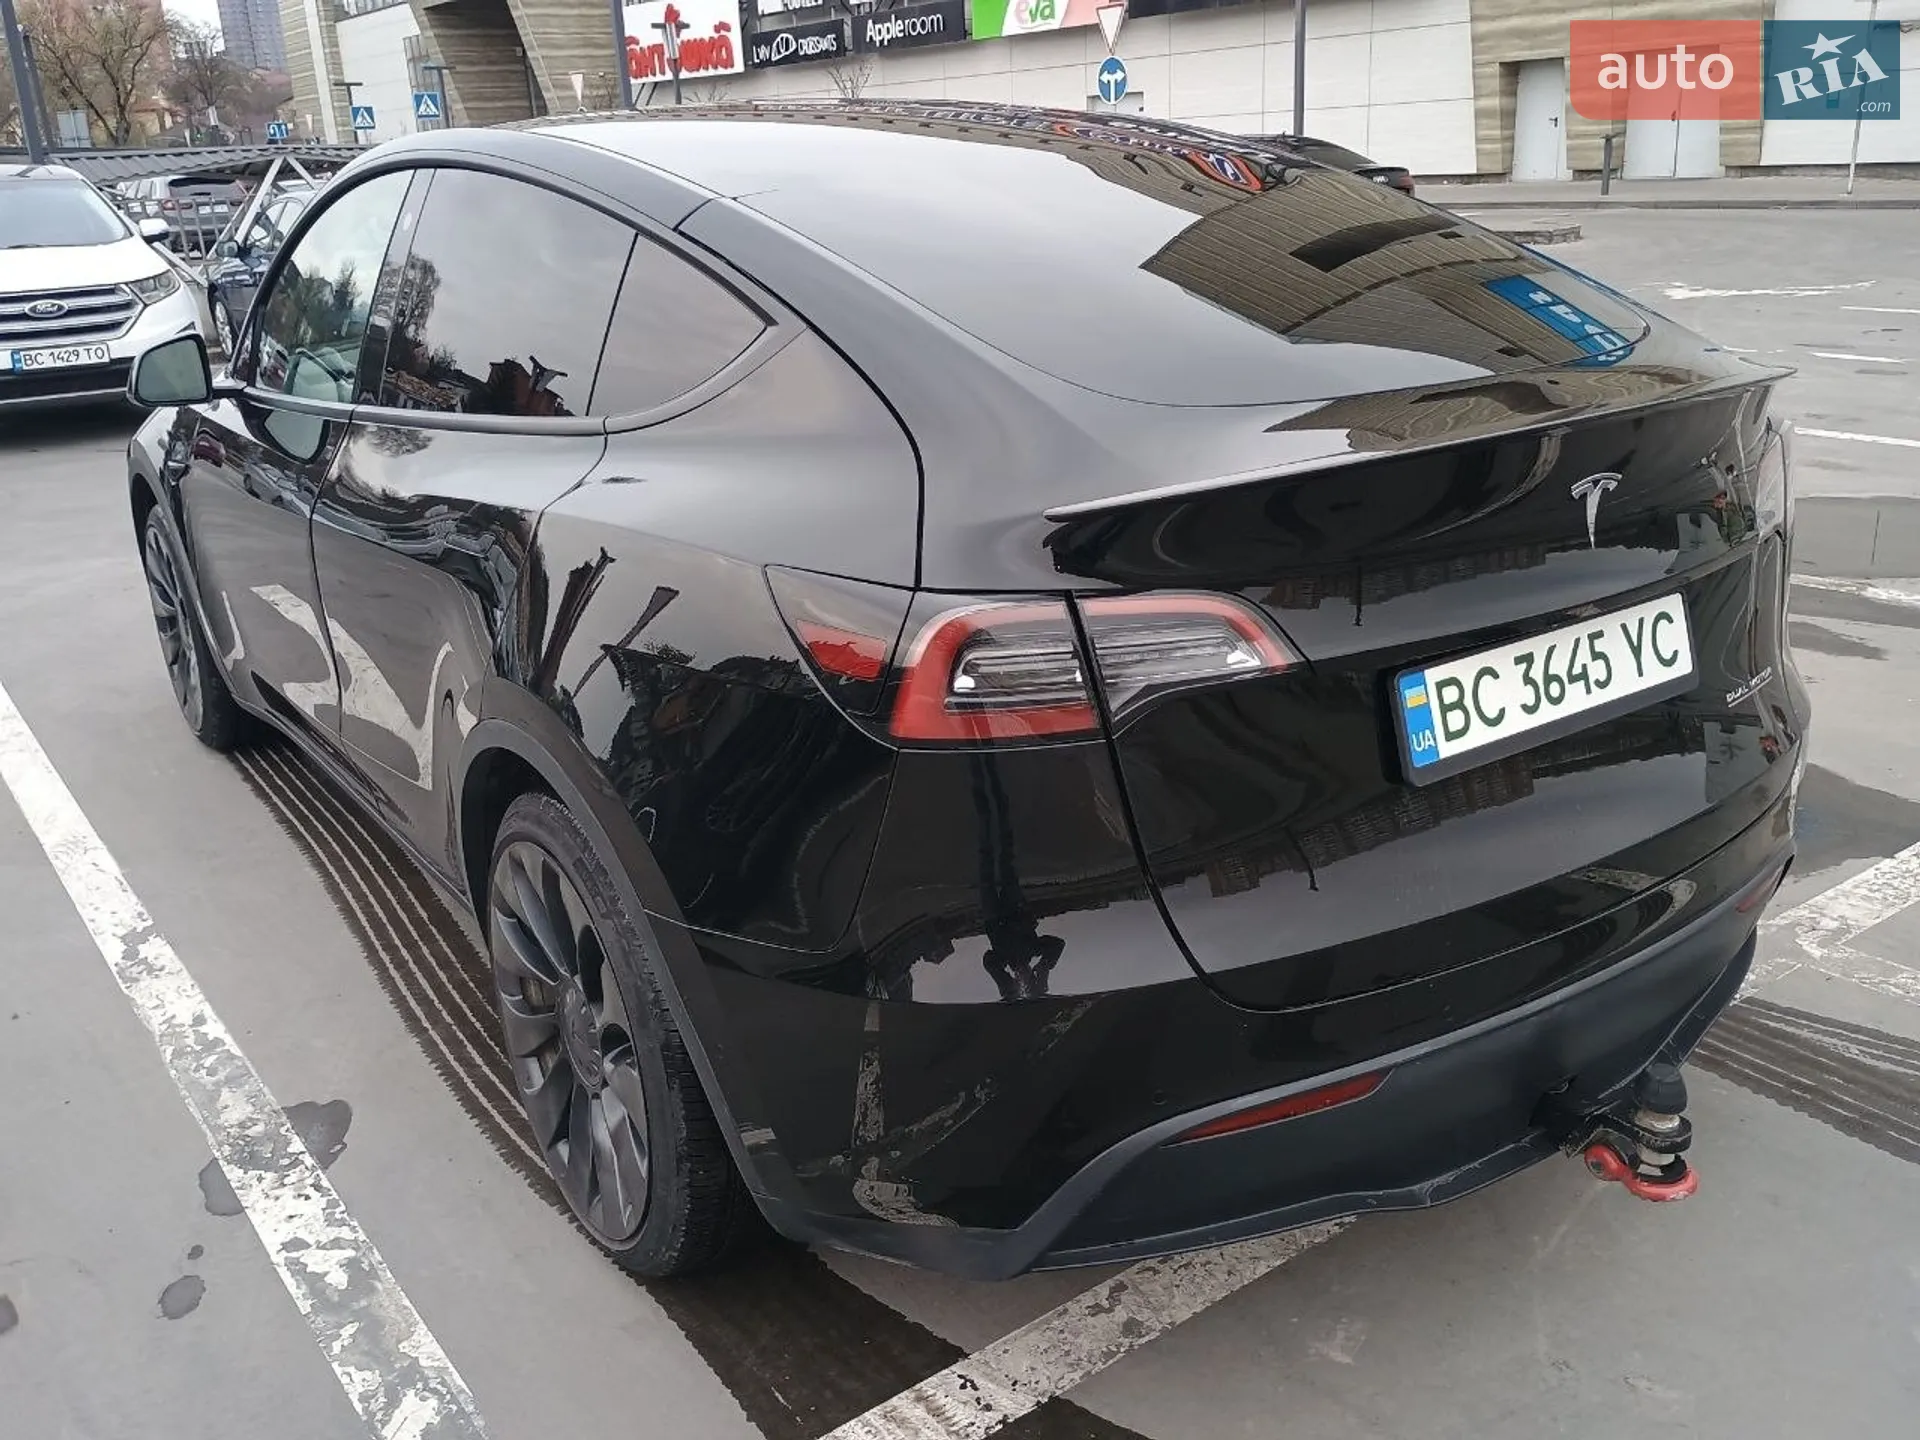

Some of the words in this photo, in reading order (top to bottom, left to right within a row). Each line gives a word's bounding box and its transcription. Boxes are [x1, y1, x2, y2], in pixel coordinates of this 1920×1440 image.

[23, 352, 45, 367] BC
[48, 349, 80, 364] 1429
[83, 347, 105, 360] TO
[1434, 666, 1506, 743] BC
[1513, 628, 1613, 715] 3645
[1620, 611, 1679, 678] YC
[1412, 728, 1436, 752] UA
